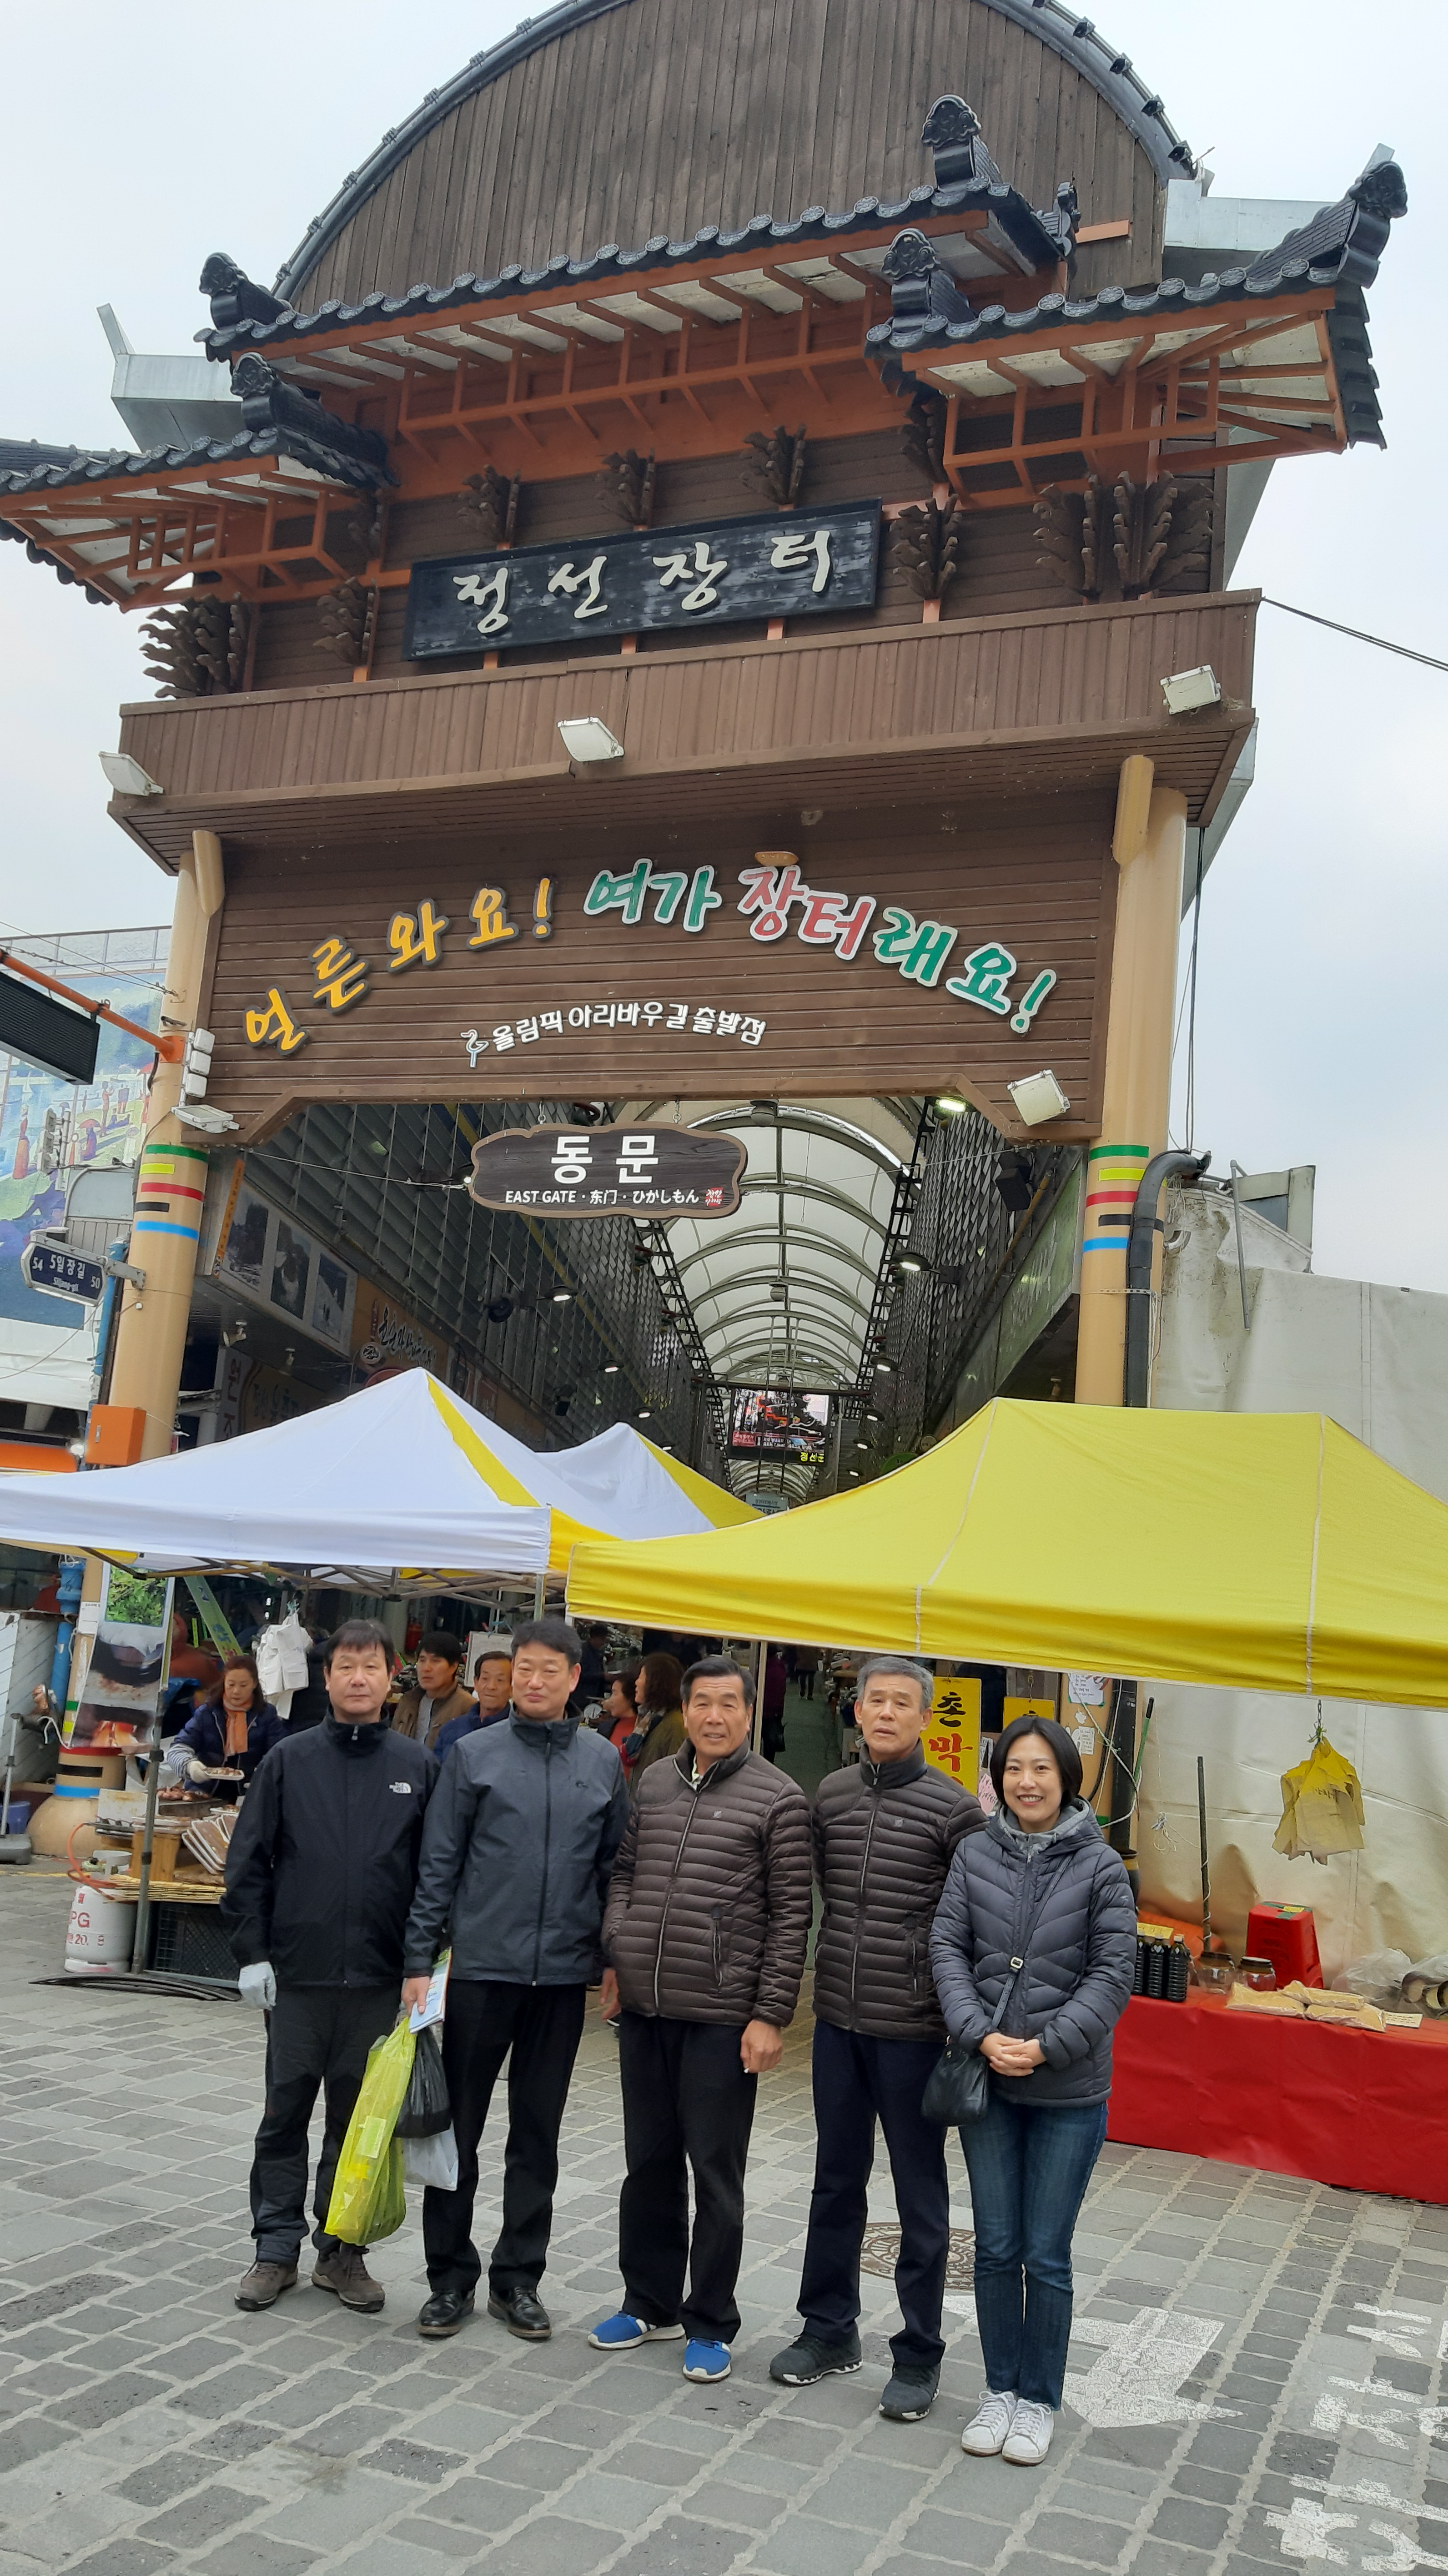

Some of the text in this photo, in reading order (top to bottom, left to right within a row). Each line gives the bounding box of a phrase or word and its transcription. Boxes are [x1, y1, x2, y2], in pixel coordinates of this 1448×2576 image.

[585, 859, 722, 932] 여가
[493, 1001, 766, 1052] 올림픽 아리바우길 출발점
[551, 1136, 659, 1184] 동문
[505, 1189, 699, 1205] EAST GATE 东门 ひがしもん
[32, 1254, 101, 1289] 54 5일장길 50
[928, 1691, 973, 1786] 촌막
[69, 1911, 90, 1928] PG
